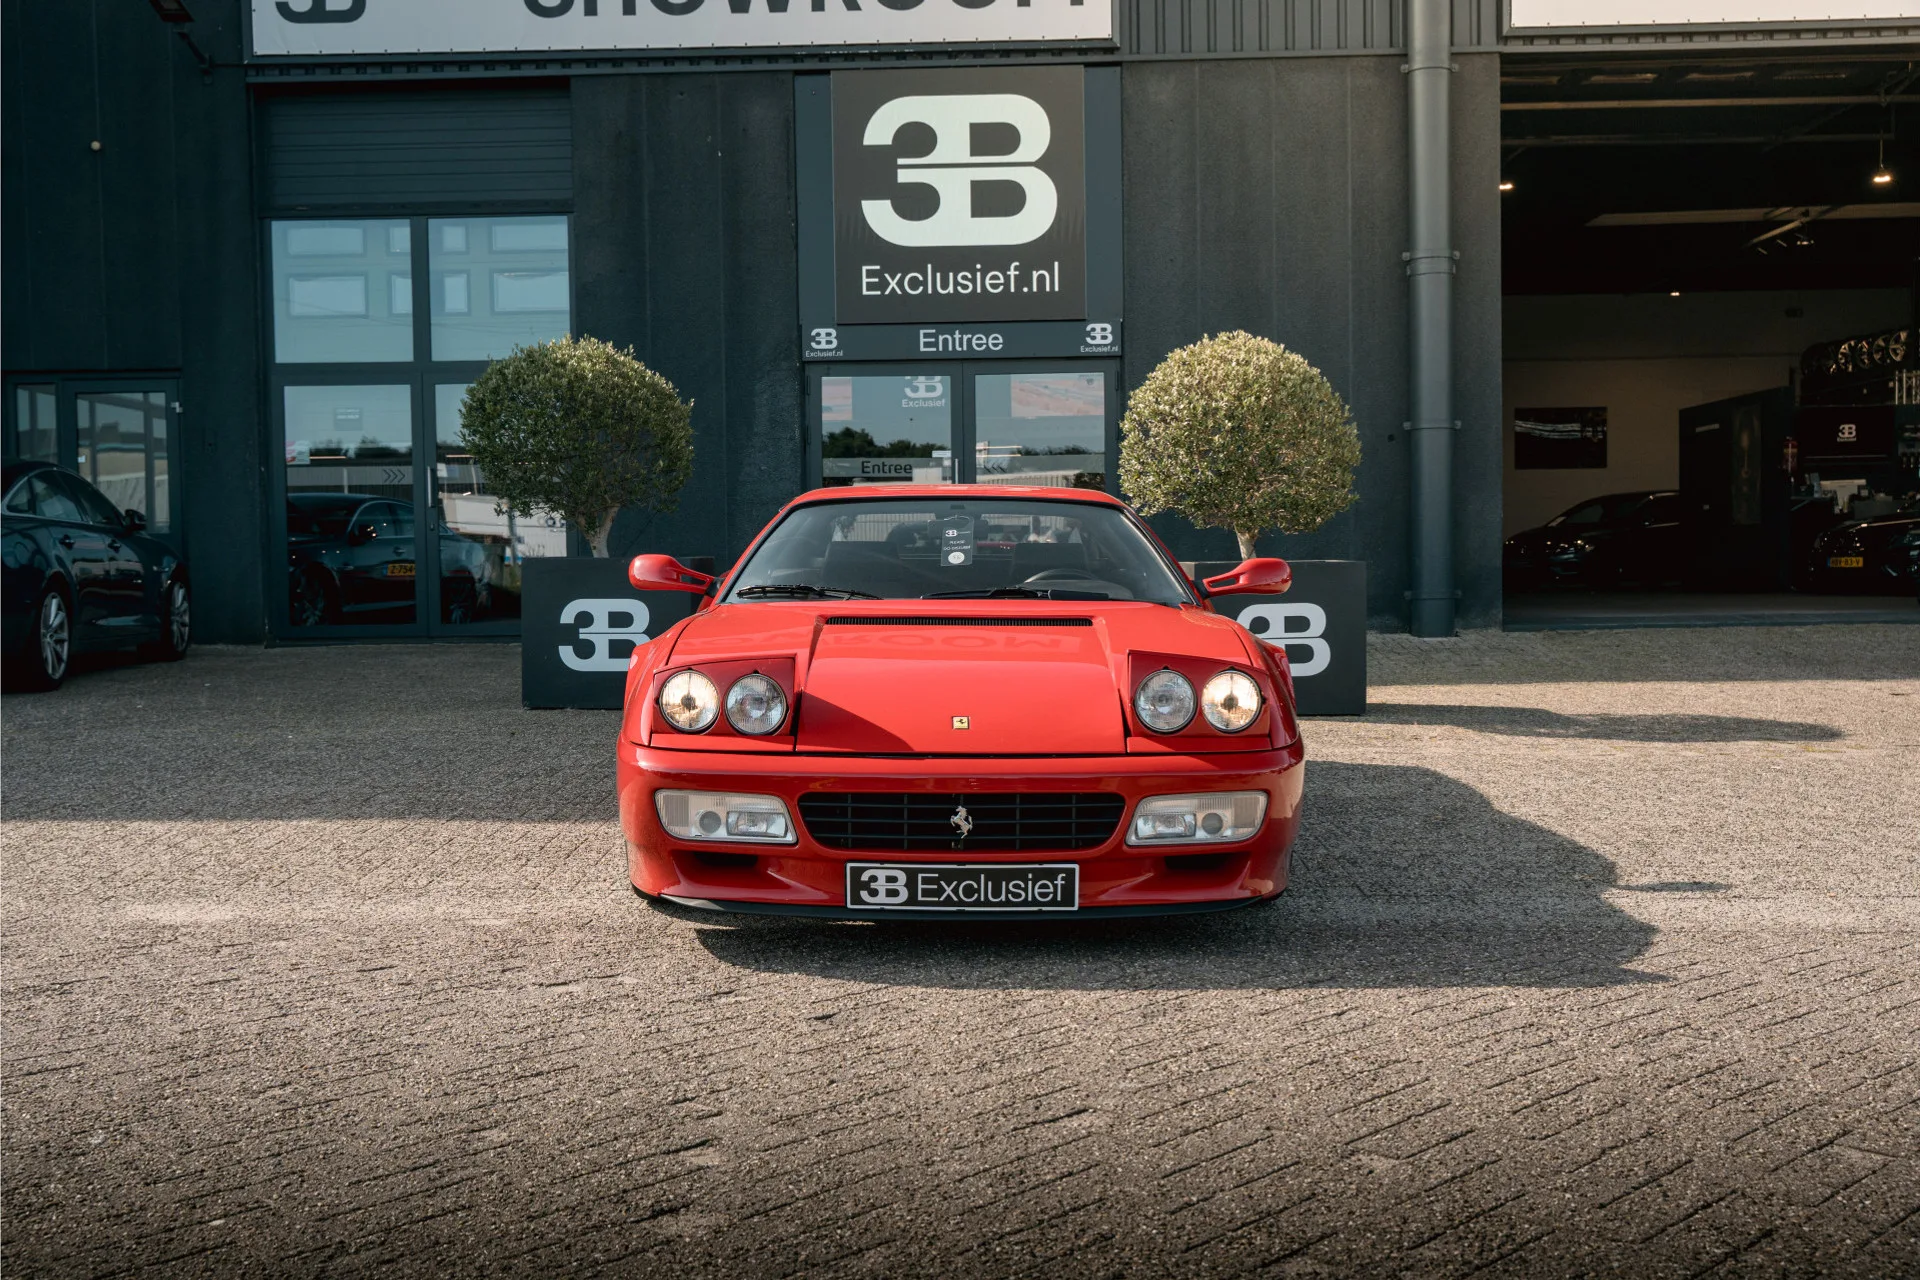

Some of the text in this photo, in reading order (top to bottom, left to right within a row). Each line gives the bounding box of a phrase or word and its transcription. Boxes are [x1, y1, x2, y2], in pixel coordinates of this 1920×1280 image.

[861, 93, 1058, 247] 3B
[861, 261, 1060, 296] Exclusief.nl
[810, 328, 838, 349] 3B
[919, 329, 1004, 352] Entree
[1085, 323, 1113, 345] 3B
[901, 399, 945, 408] Exclusief
[1838, 424, 1857, 438] 3B
[861, 461, 912, 474] Entree
[558, 598, 651, 672] 3B
[859, 868, 1066, 904] 3B Exclusief
